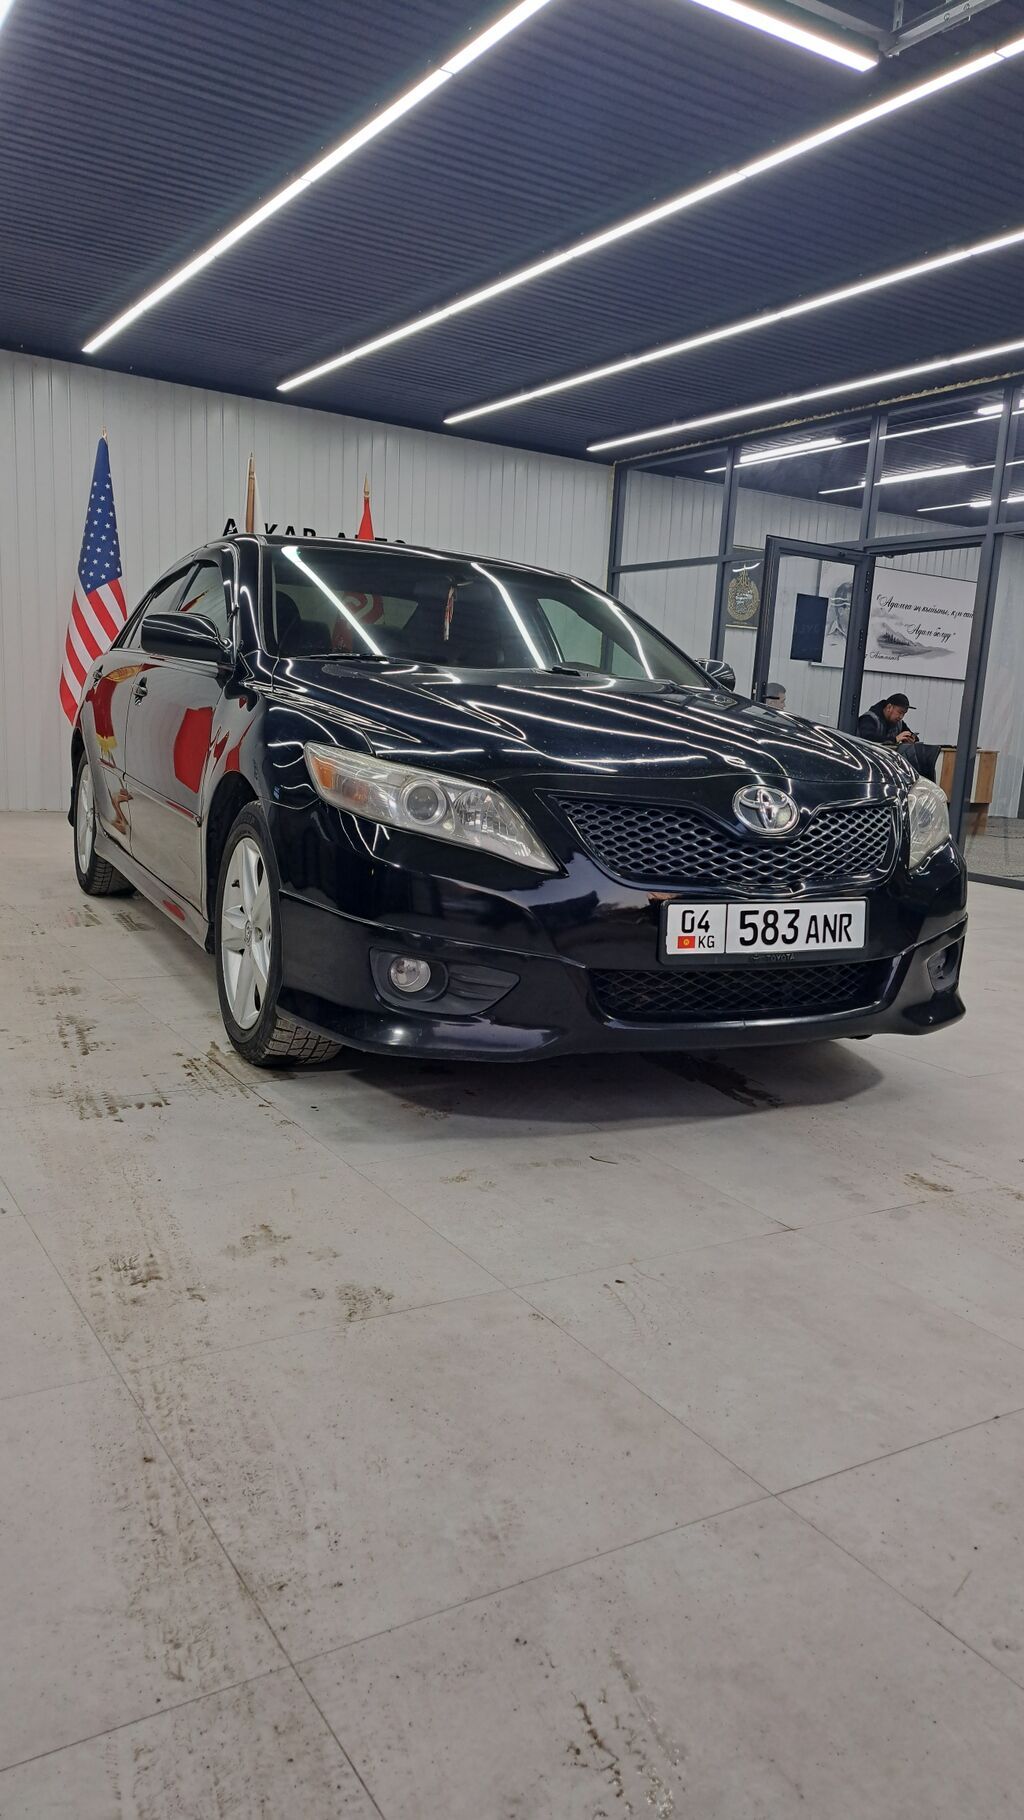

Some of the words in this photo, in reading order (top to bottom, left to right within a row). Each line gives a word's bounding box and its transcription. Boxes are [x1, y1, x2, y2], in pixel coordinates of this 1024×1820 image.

[681, 909, 711, 934] 04
[739, 908, 801, 947] 583
[805, 913, 853, 945] ANR
[698, 935, 715, 949] KG
[766, 953, 795, 961] TOYOTA
